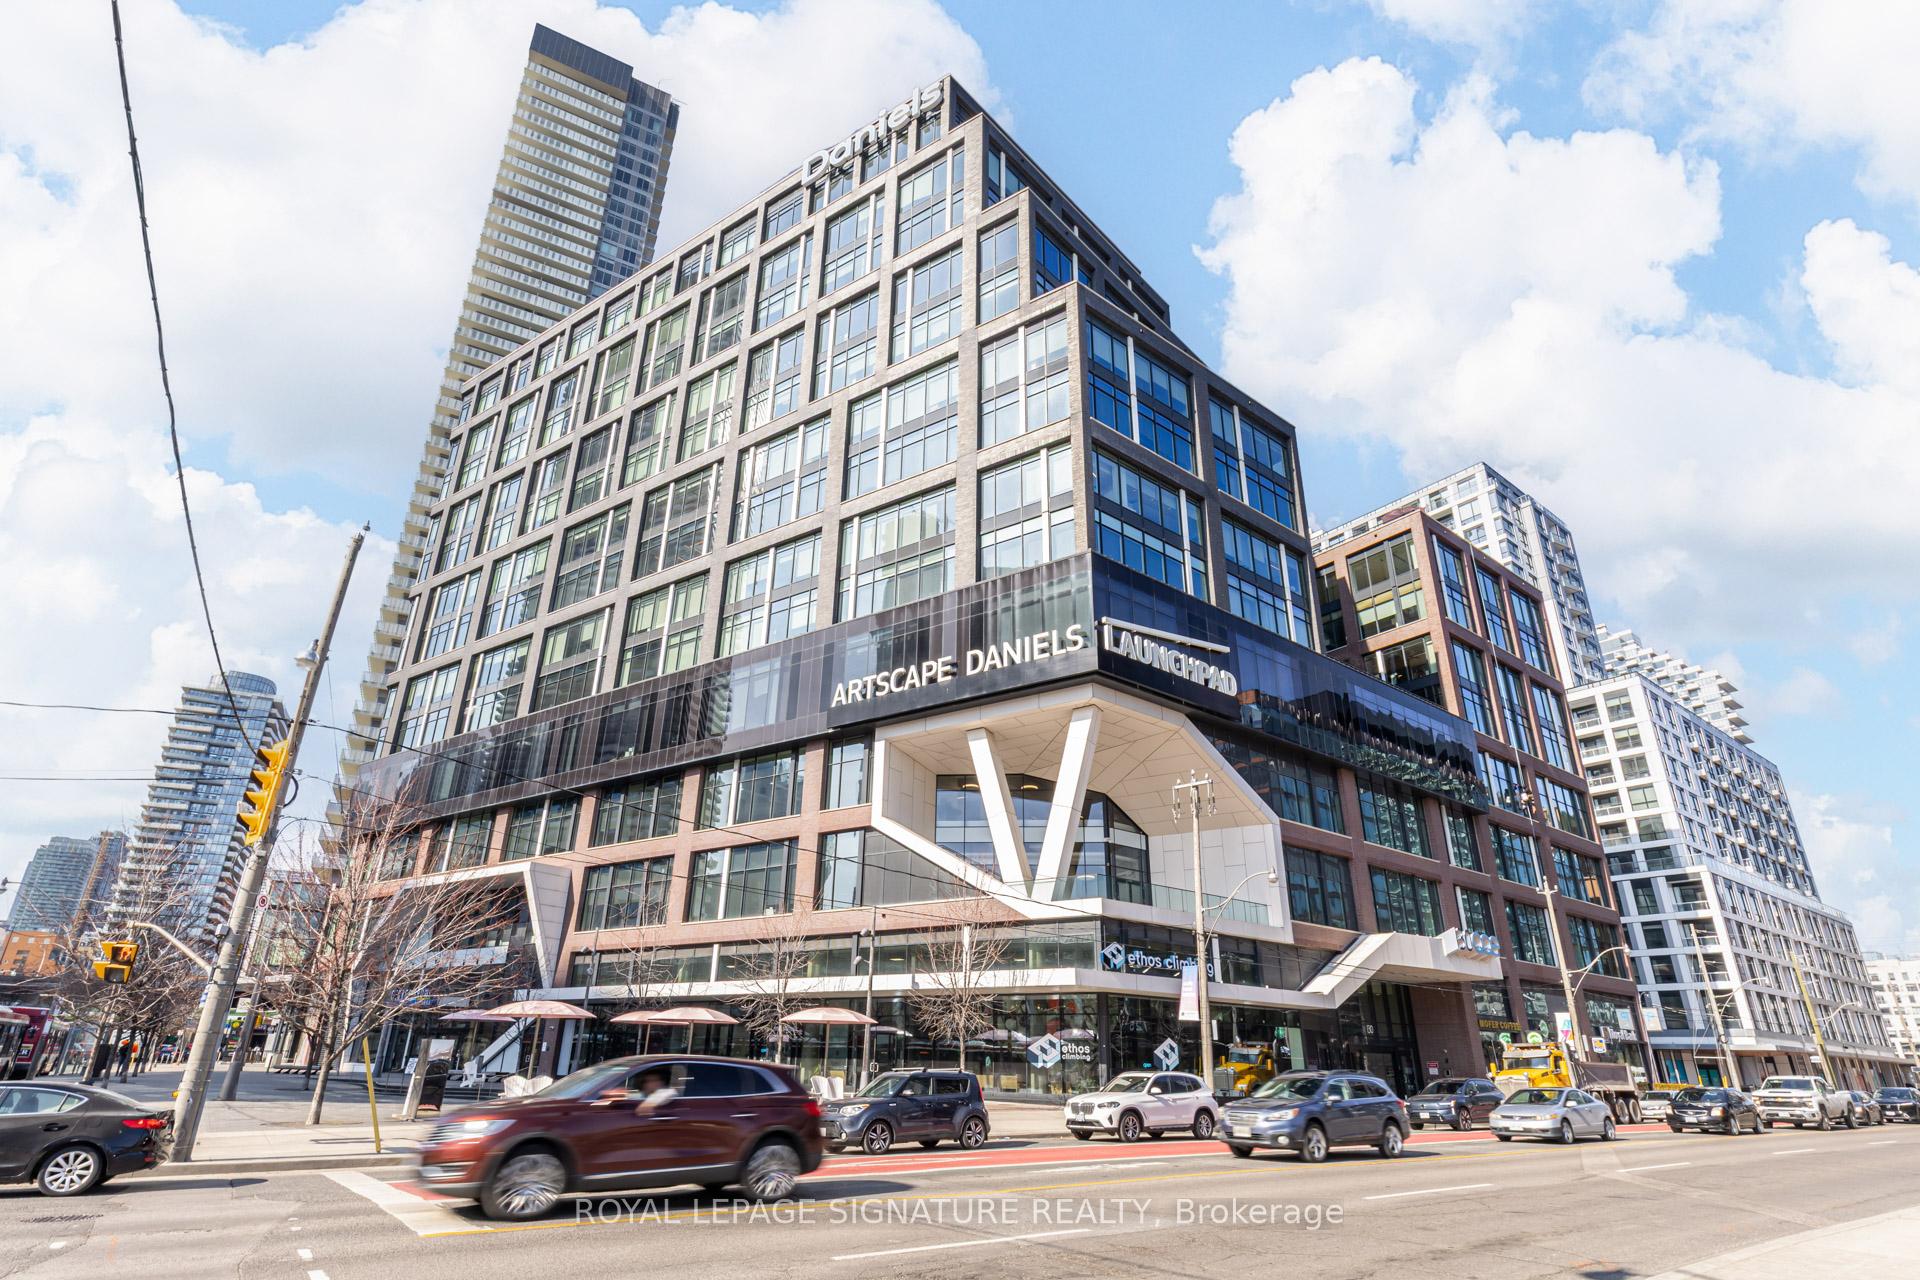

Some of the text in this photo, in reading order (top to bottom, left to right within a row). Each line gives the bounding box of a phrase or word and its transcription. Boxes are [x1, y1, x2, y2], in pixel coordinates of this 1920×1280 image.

[801, 80, 943, 188] Daniels
[831, 624, 1084, 708] ARTSCAPE DANIELS
[1103, 624, 1238, 697] LAUNCHPAD
[1127, 950, 1214, 977] ethos climbg
[1061, 1043, 1090, 1054] ethos
[1061, 1053, 1091, 1062] climbing
